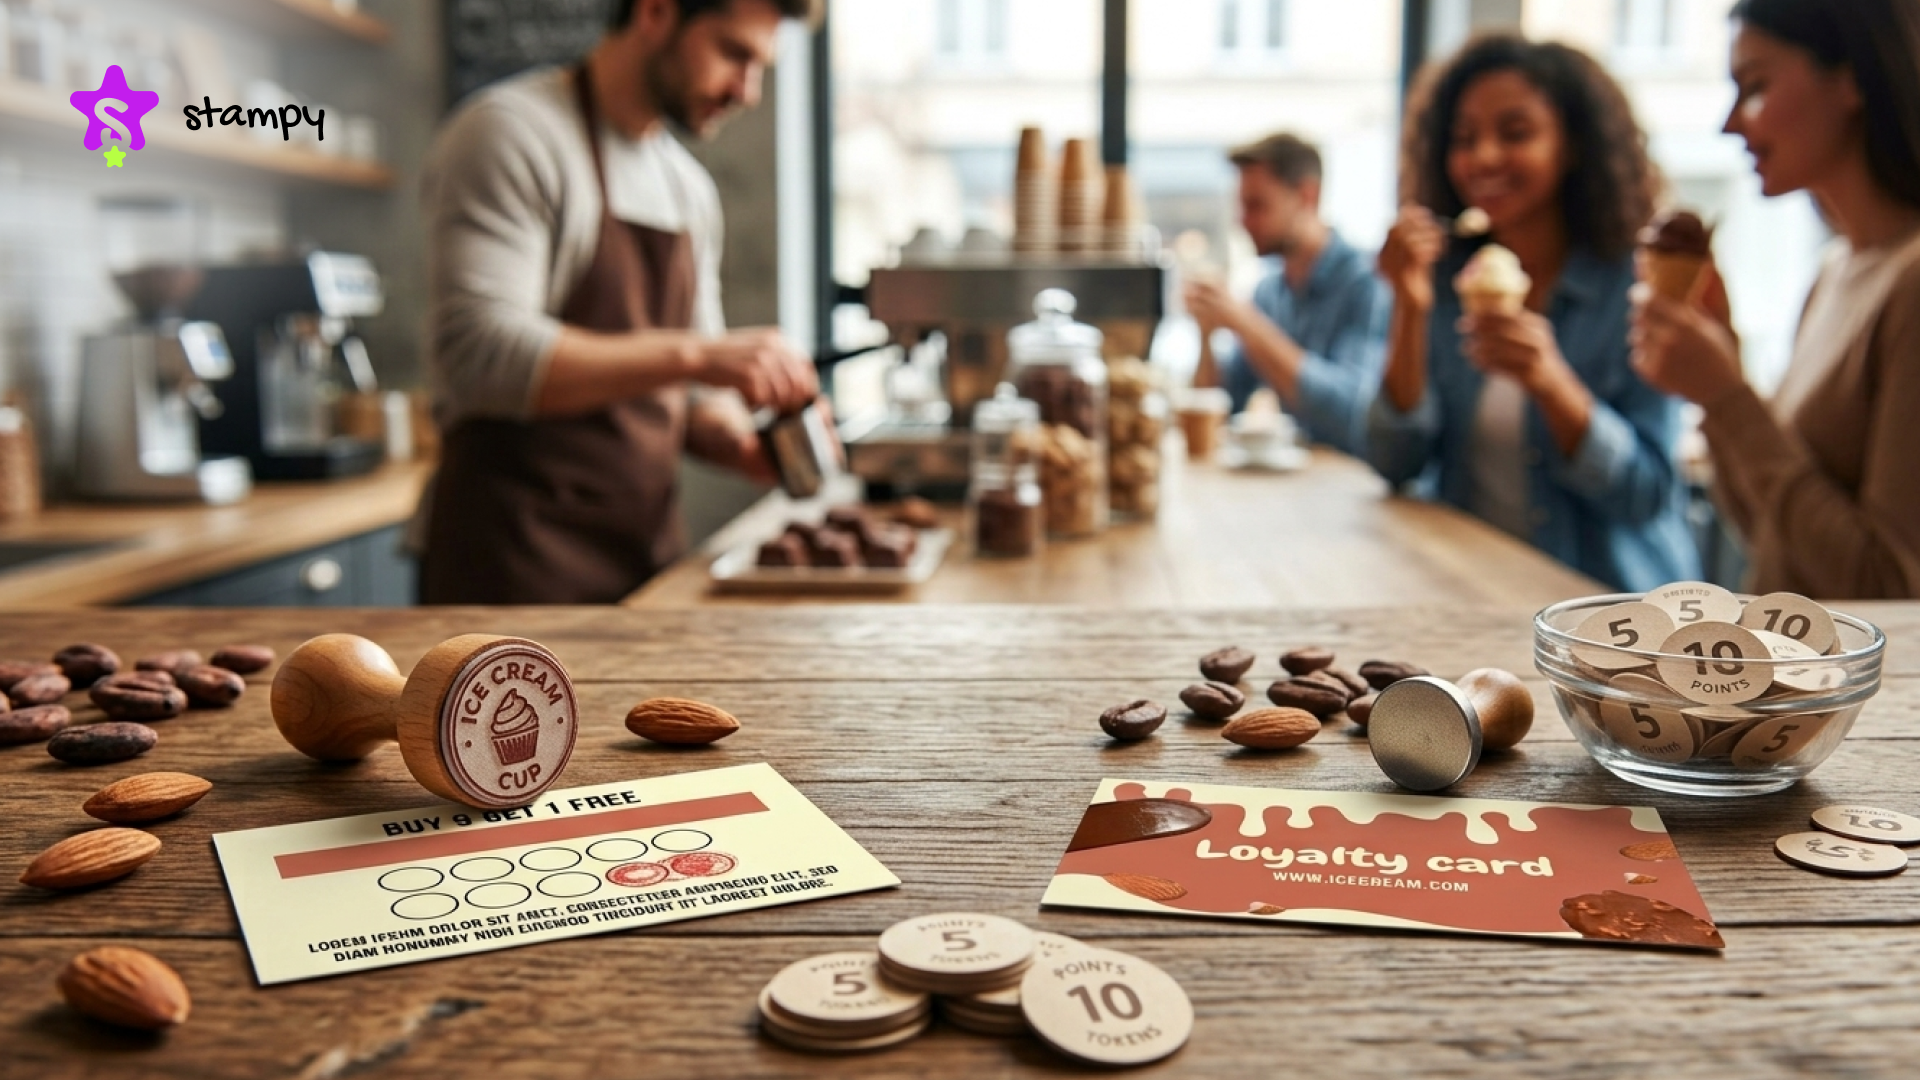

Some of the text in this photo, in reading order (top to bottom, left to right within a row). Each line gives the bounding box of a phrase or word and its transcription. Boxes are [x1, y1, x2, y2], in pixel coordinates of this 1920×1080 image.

[1679, 600, 1704, 622] 5
[1764, 609, 1811, 641] 10
[1608, 617, 1639, 647] 5
[1683, 640, 1744, 675] 10
[461, 662, 564, 724] ICE CREAM
[1691, 679, 1750, 694] POINTS
[1628, 703, 1661, 739] 5
[1761, 724, 1800, 753] 5
[498, 763, 541, 790] CUP
[382, 816, 441, 837] BUY
[452, 813, 472, 826] 9
[545, 802, 561, 814] 1
[567, 790, 642, 811] FREE
[1195, 839, 1554, 878] Loyalty card
[334, 946, 379, 962] DIAM
[942, 930, 978, 952] 5
[833, 971, 867, 996] 5
[1053, 960, 1127, 980] POINTS
[1067, 982, 1143, 1023] 10
